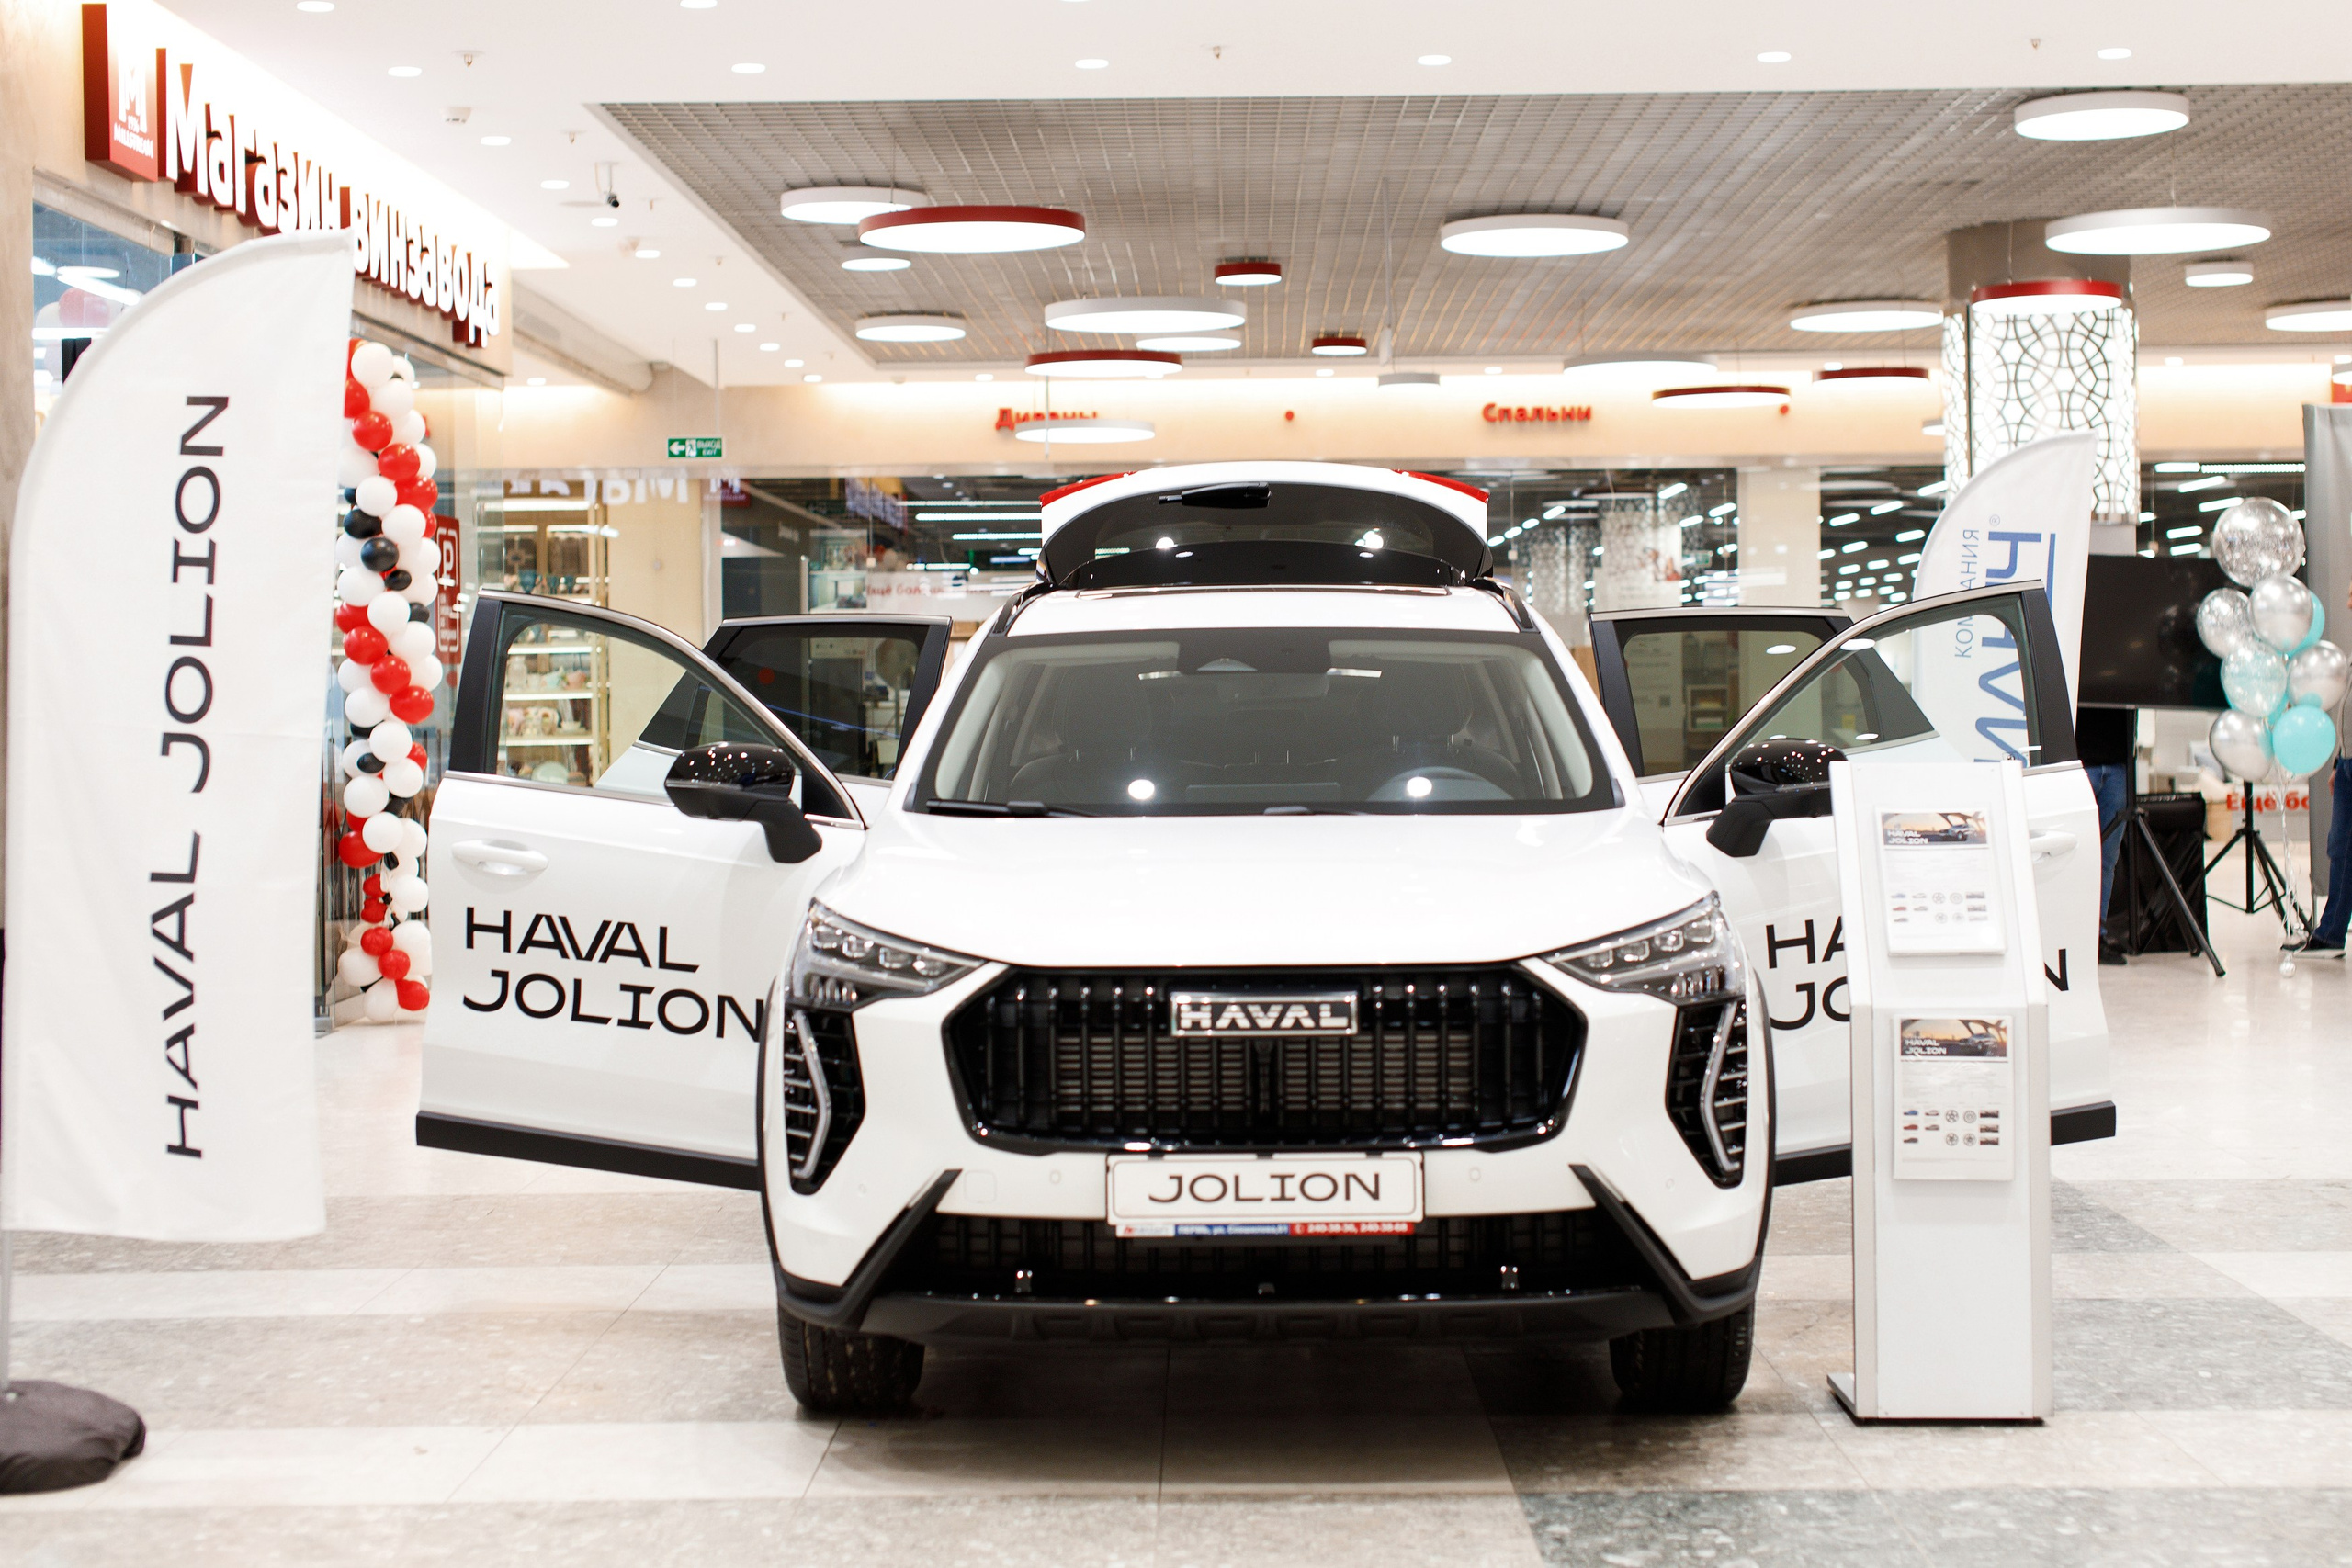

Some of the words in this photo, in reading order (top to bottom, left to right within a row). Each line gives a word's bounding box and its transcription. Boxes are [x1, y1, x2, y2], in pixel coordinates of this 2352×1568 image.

[157, 48, 340, 232] Магазин
[341, 186, 500, 347] винзавода
[1482, 402, 1592, 423] Спальни
[159, 395, 230, 795] JOLION
[1954, 529, 1979, 658] КОМАНИЯ
[466, 907, 700, 973] HAVAL
[150, 830, 205, 1160] HAVAL
[463, 969, 764, 1043] JOLION
[1180, 1003, 1349, 1029] HAVAL
[1148, 1172, 1381, 1203] JOLION
